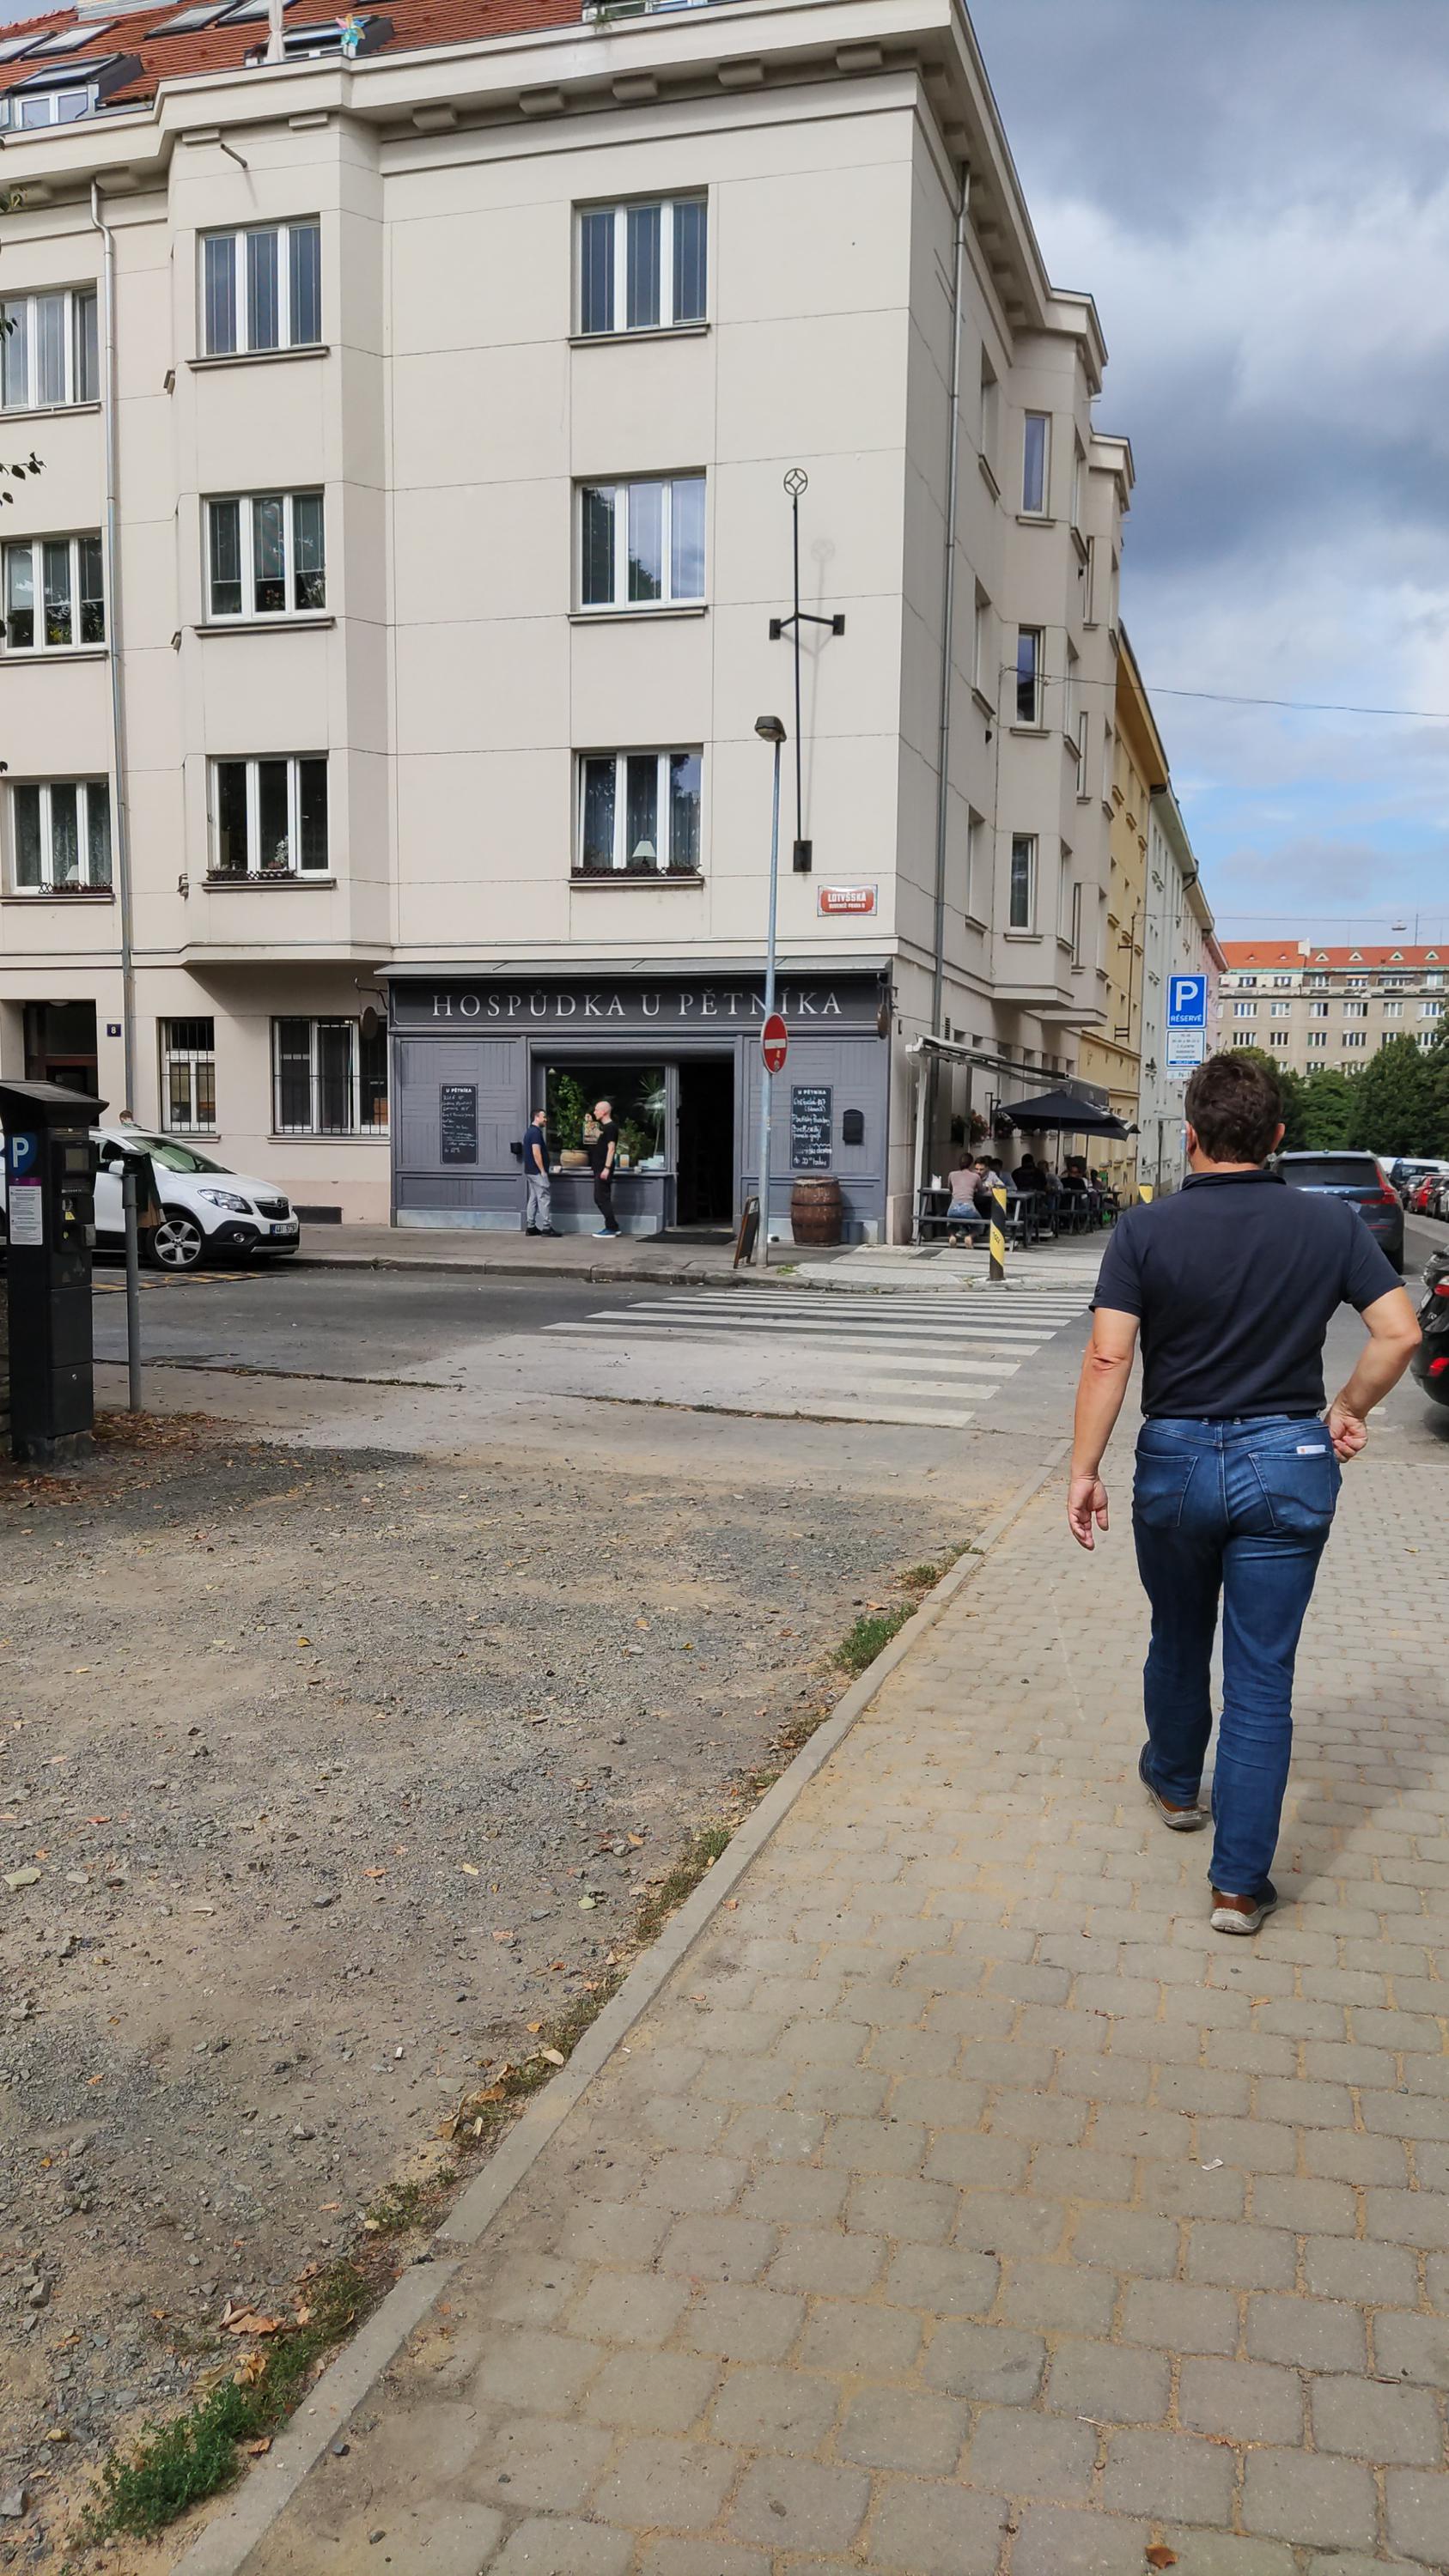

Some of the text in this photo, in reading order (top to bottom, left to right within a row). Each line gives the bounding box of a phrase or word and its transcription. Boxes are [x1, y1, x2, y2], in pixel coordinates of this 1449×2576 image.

[828, 891, 866, 902] LOTYŠSKÁ
[432, 987, 843, 1017] HOSPŮDKA U PĚTNÍKA
[1176, 981, 1198, 1012] P
[111, 1026, 117, 1035] 8
[12, 1137, 29, 1168] P
